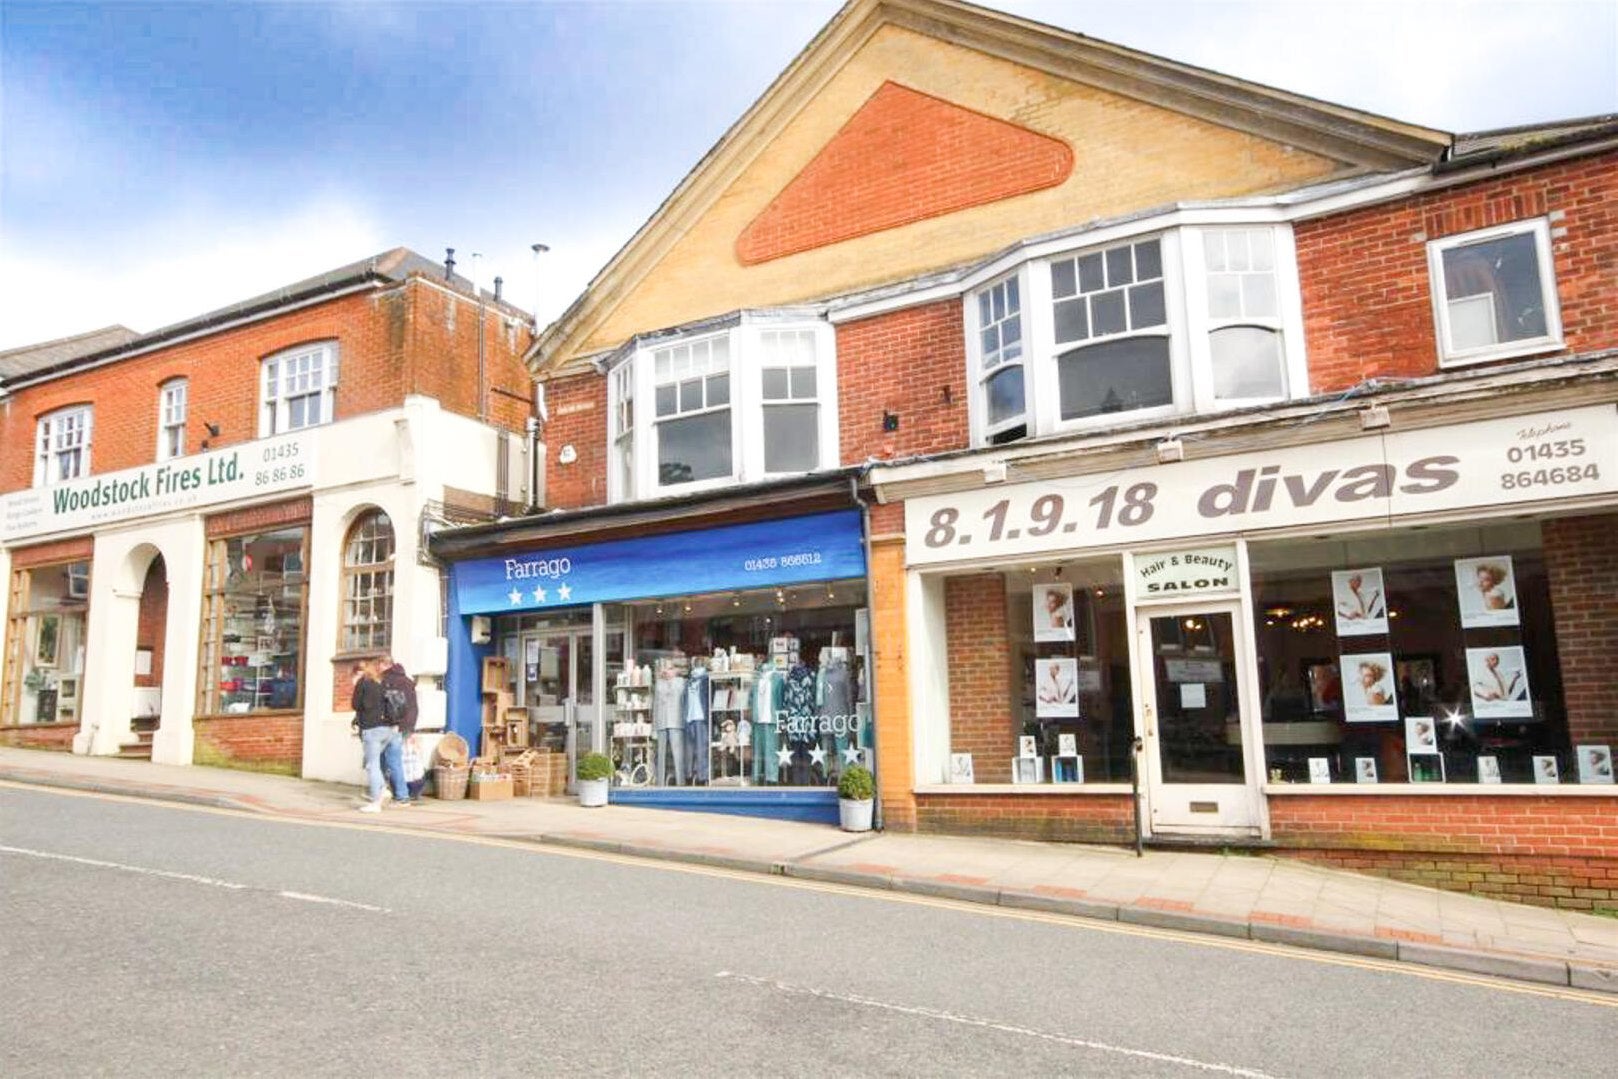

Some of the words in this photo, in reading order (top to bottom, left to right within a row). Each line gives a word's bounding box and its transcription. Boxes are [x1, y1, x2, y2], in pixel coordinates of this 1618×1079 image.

[263, 442, 298, 463] 01435
[1507, 438, 1586, 463] 01435
[53, 471, 150, 515] Woodstock
[156, 465, 201, 497] Fires
[207, 452, 244, 486] Ltd.
[255, 471, 269, 486] 86
[272, 467, 287, 482] 86
[289, 463, 305, 479] 86
[1501, 463, 1600, 490] 864684
[924, 482, 1158, 549] 8.1.9.18
[1197, 455, 1460, 518] divas
[505, 557, 571, 580] Farrago
[1141, 560, 1166, 578] Hair
[1171, 556, 1179, 566] &
[1184, 554, 1233, 572] Beauty
[1147, 577, 1229, 592] SALON
[774, 709, 861, 737] Farrago
